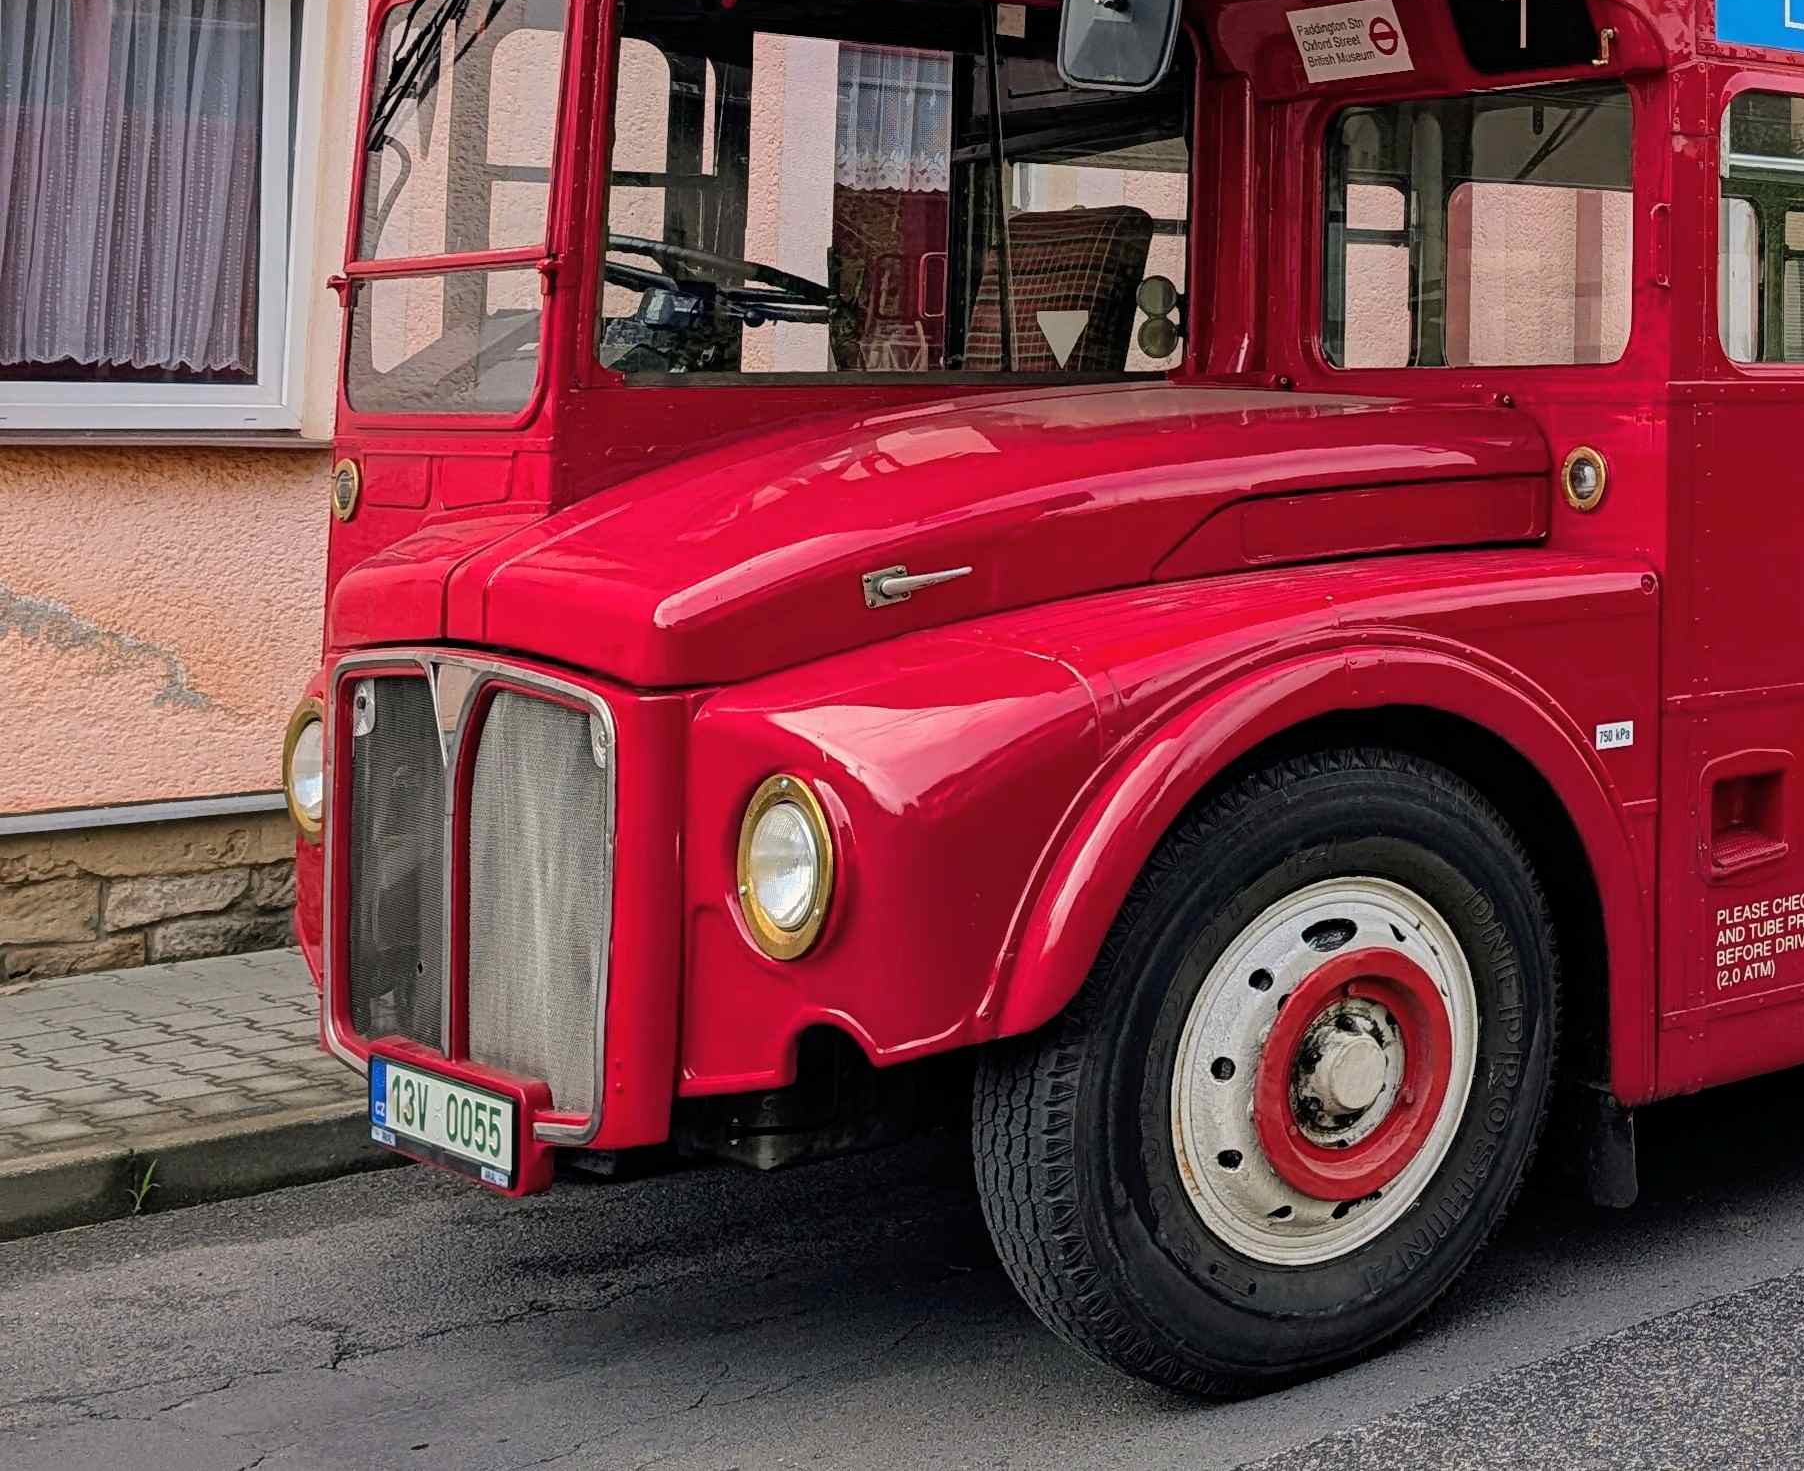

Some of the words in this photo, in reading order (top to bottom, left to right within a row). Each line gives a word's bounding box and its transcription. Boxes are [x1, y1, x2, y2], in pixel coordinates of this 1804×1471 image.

[1296, 21, 1347, 36] Paddington
[1333, 35, 1361, 48] Street
[1307, 53, 1336, 68] British
[1335, 50, 1376, 63] Museum
[1599, 729, 1613, 744] 750
[1615, 727, 1631, 740] kPa
[1717, 901, 1769, 926] PLEASE
[1716, 926, 1745, 947] AND
[1749, 917, 1785, 938] TUBE
[1716, 942, 1772, 967] BEFORE
[1743, 959, 1776, 981] ATM)
[392, 1074, 429, 1132] 13V
[446, 1092, 502, 1158] 0055
